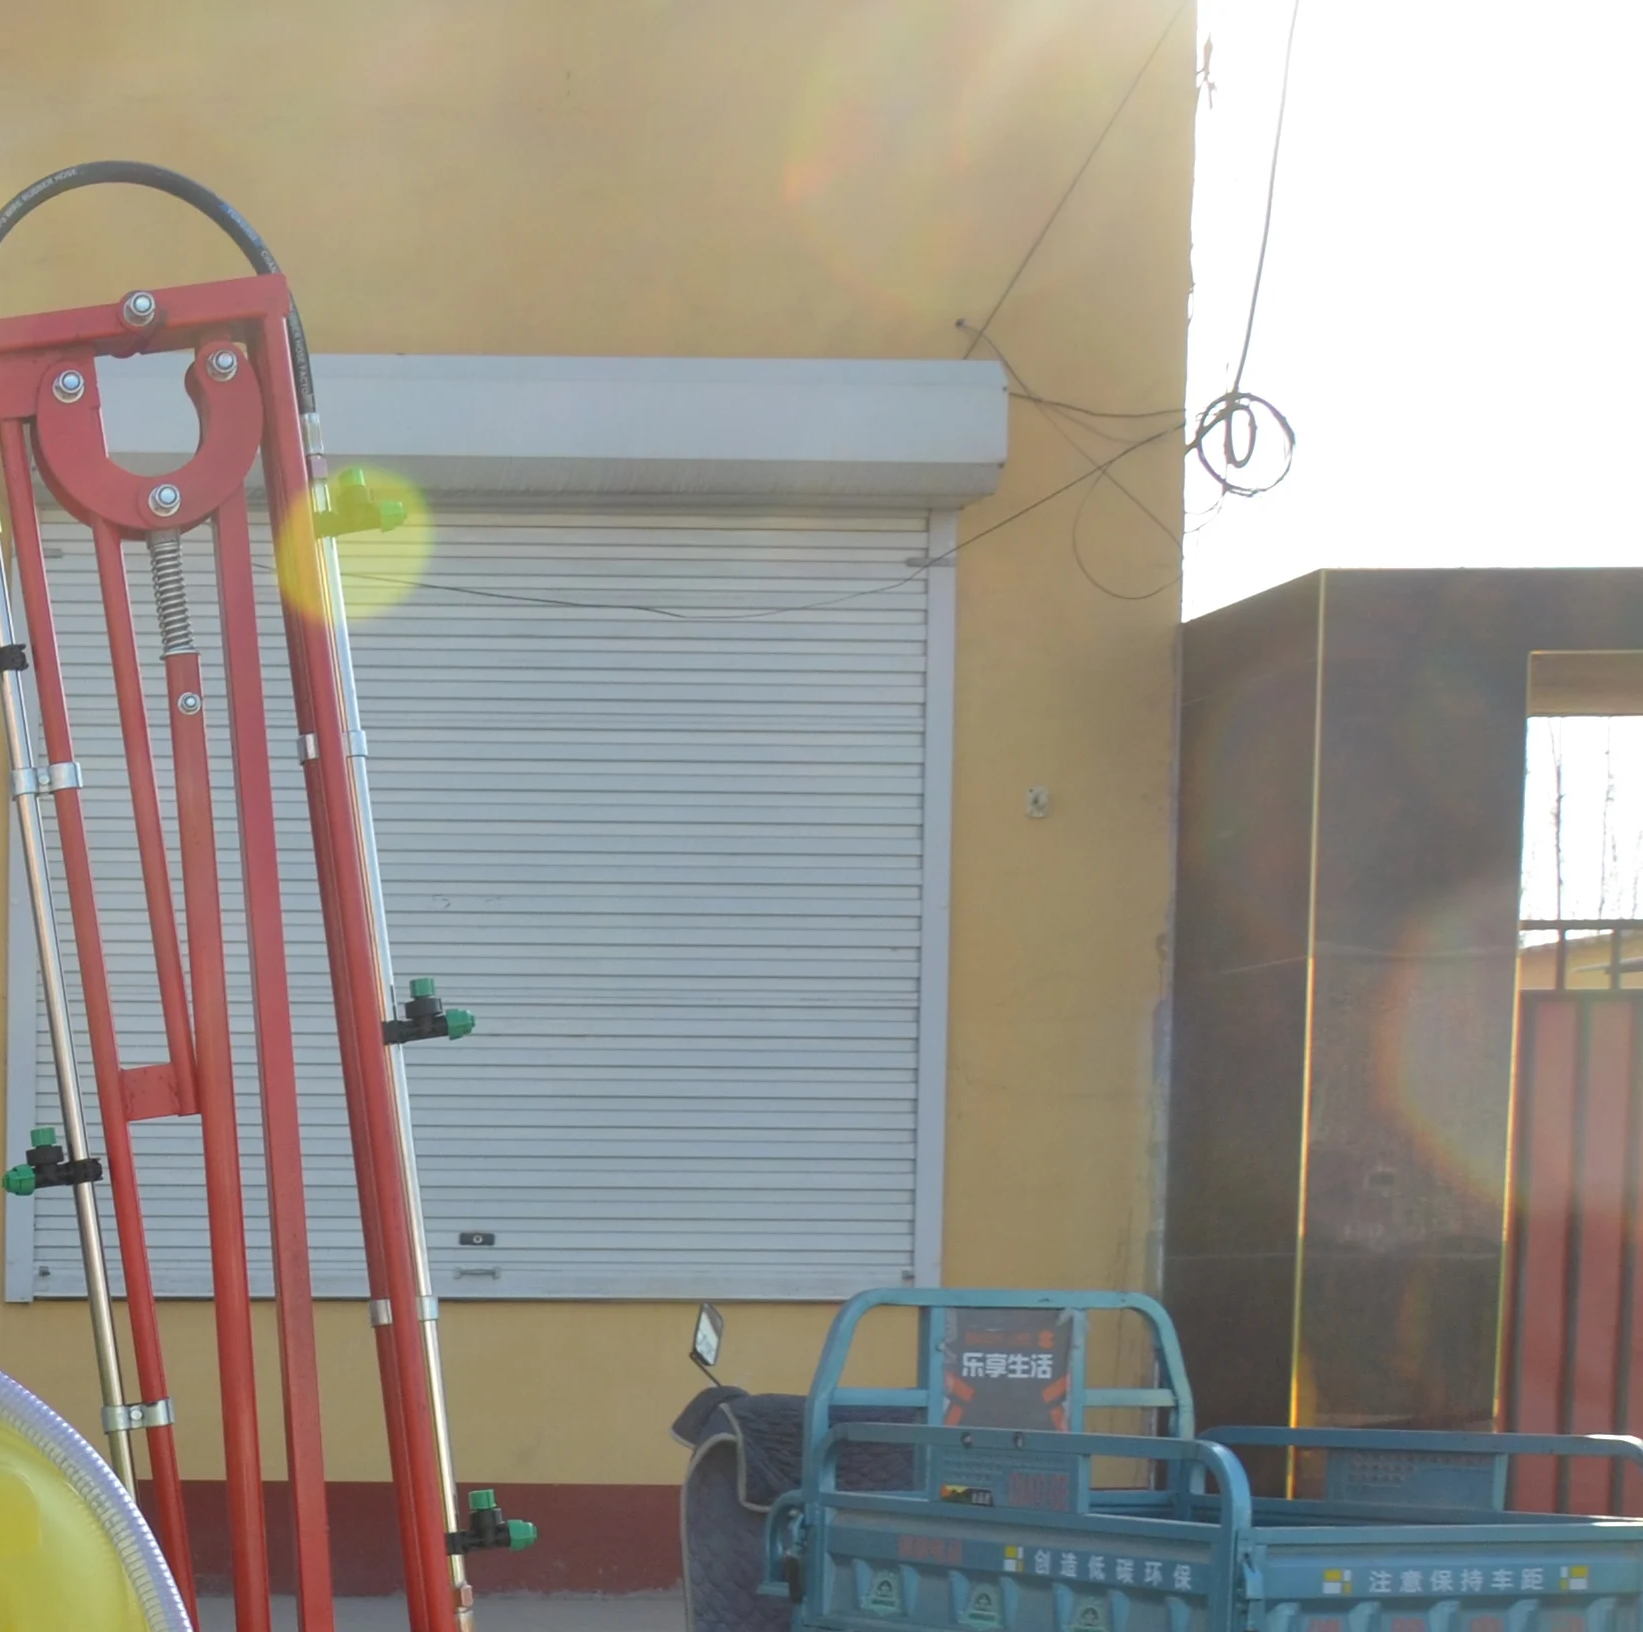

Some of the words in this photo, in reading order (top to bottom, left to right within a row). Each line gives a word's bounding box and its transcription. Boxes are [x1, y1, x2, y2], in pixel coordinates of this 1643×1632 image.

[961, 1352, 1054, 1379] 乐享生活
[1034, 1549, 1193, 1592] 创造低碳环保
[1369, 1567, 1545, 1594] 注意保持车距
